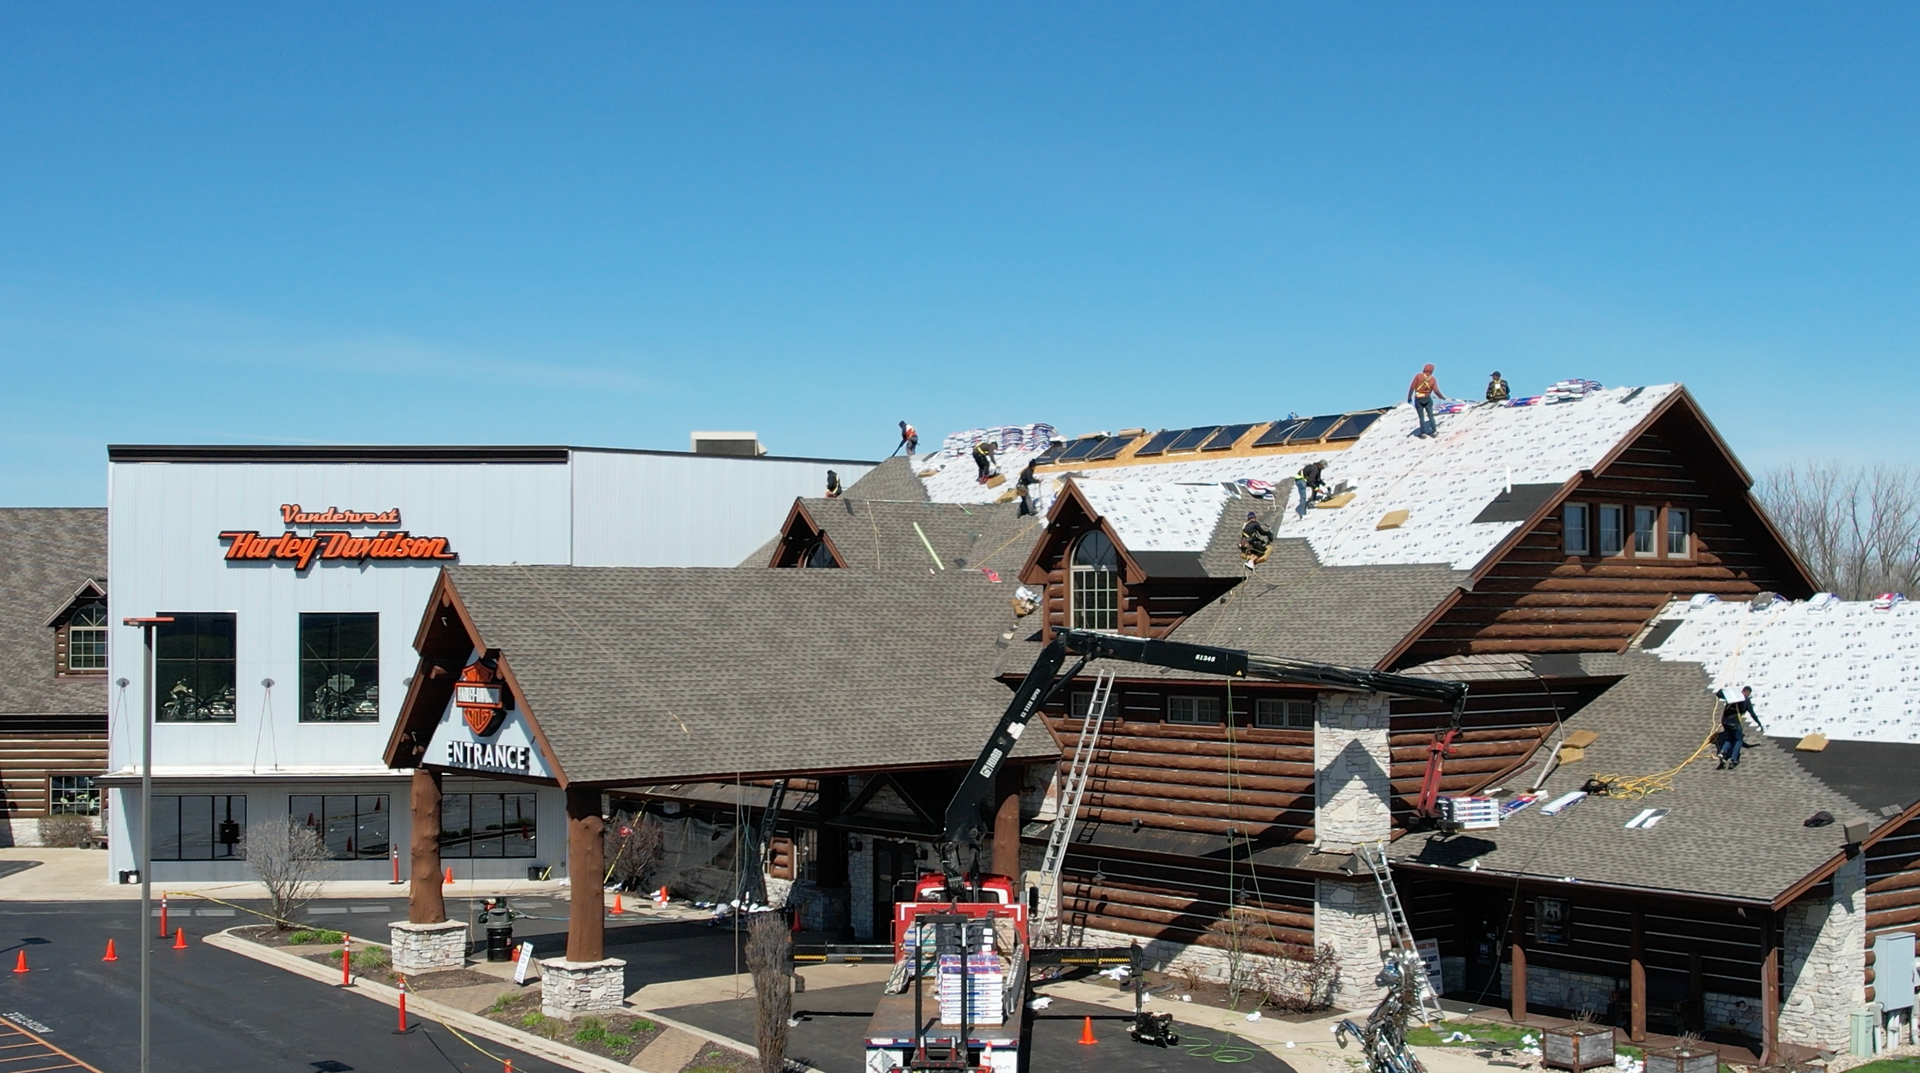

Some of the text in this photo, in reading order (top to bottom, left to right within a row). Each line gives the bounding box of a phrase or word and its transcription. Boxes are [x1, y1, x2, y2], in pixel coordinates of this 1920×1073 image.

[281, 503, 400, 523] Vandervest
[219, 531, 458, 570] Harley-Davidson
[445, 740, 526, 770] ENTRANCE
